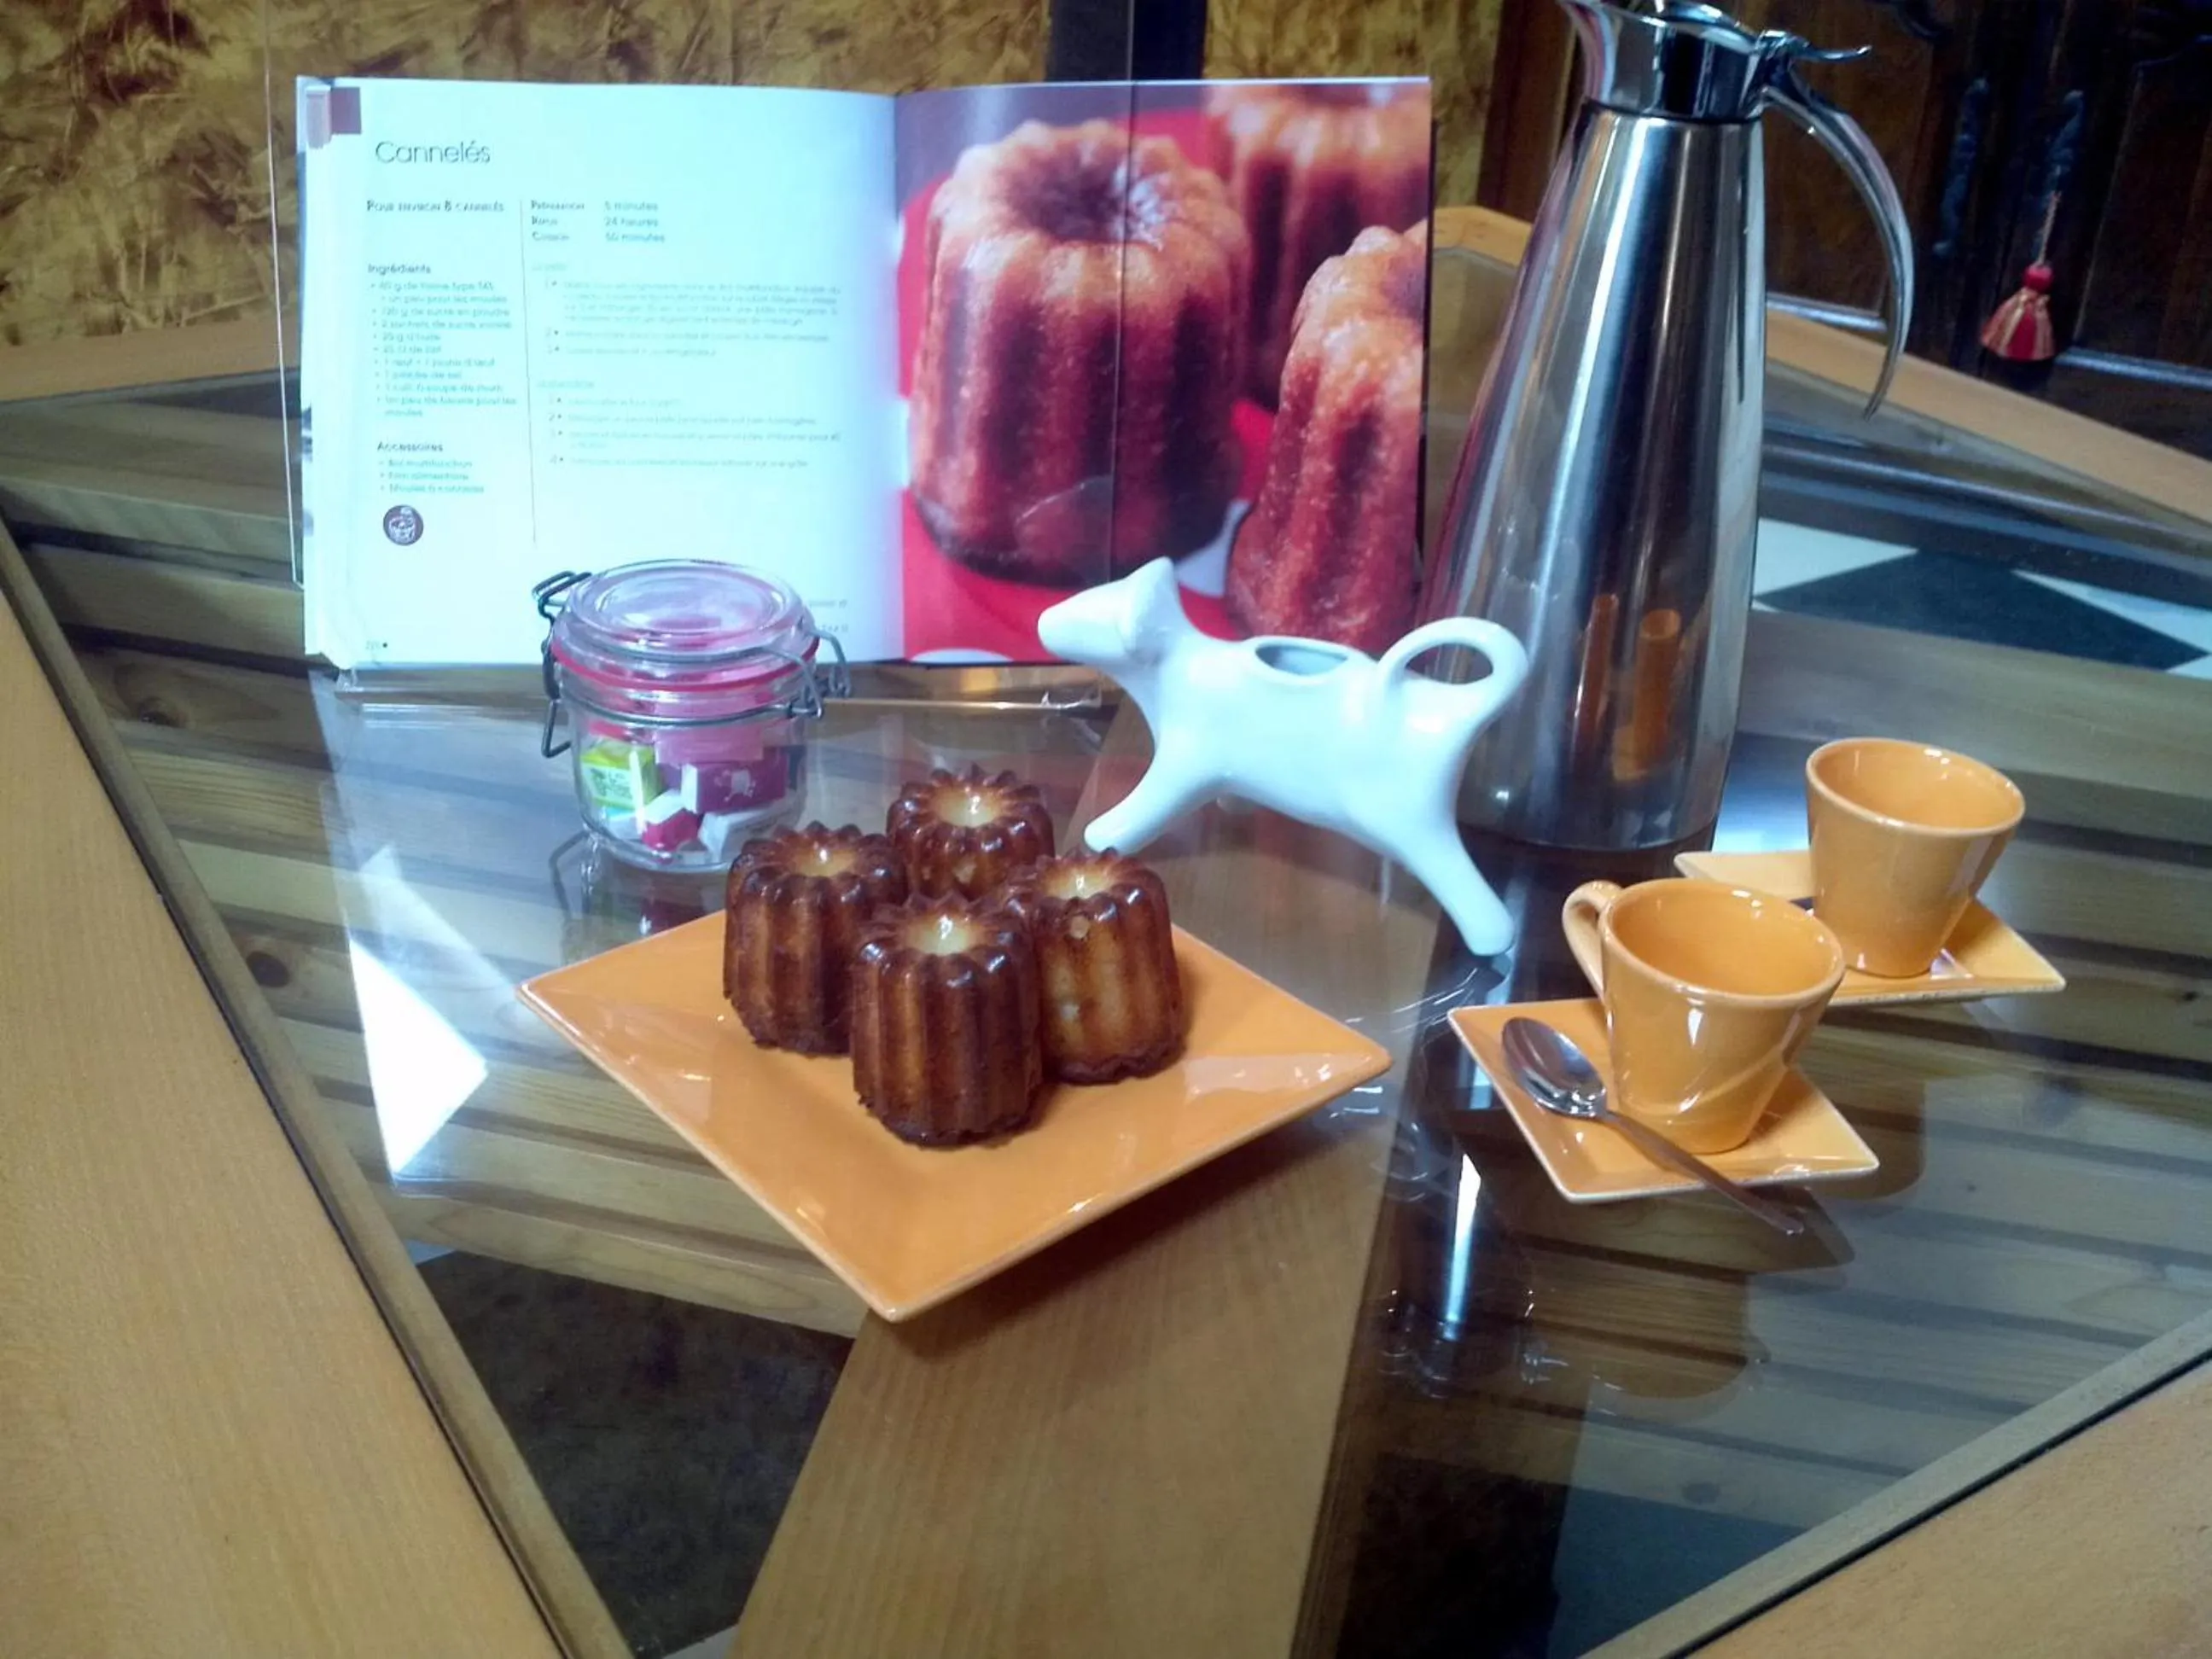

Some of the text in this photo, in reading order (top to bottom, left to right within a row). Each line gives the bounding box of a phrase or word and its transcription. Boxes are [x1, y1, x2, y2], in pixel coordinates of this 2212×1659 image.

[375, 140, 491, 164] Cannelés
[368, 263, 431, 276] Ingrédients
[377, 441, 444, 452] Accessoires
